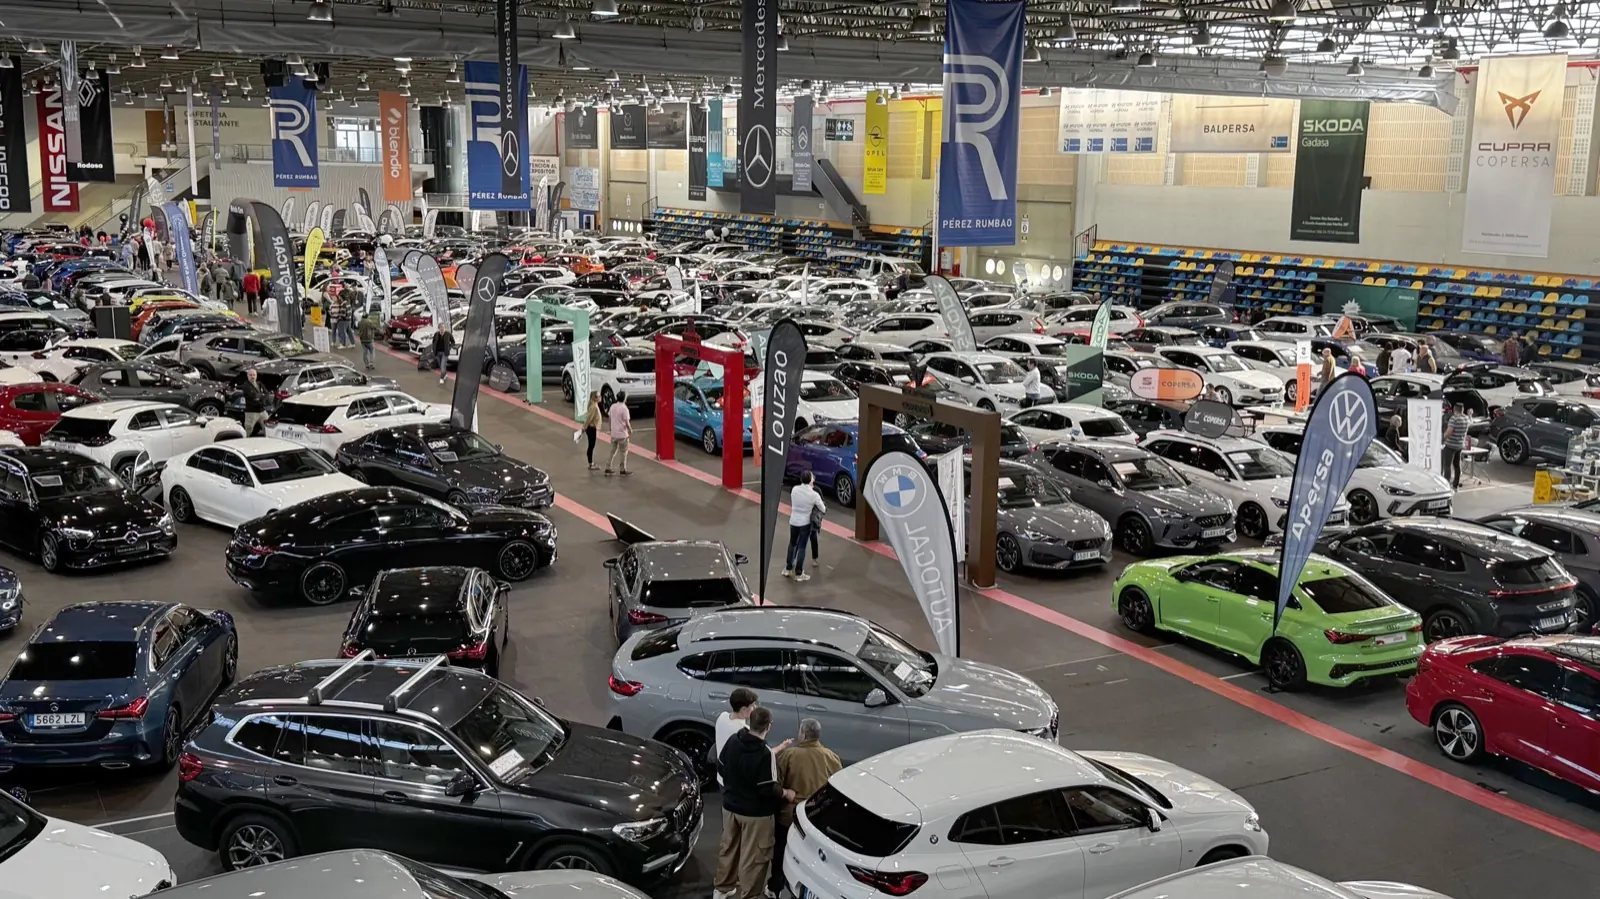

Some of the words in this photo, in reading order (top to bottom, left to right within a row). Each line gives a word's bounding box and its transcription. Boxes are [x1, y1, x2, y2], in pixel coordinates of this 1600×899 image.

[1204, 124, 1255, 133] BALPERSA
[45, 86, 71, 206] NISSAN
[1302, 137, 1329, 147] Gadasa
[1479, 143, 1551, 152] CUPRA
[389, 127, 401, 178] blendio
[1476, 155, 1550, 168] COPERSA
[471, 191, 496, 199] PÉREZ
[942, 217, 972, 228] PÉREZ
[975, 218, 1013, 228] RUMBAO
[1067, 371, 1100, 380] SKODA
[1161, 381, 1197, 389] COPERSA
[768, 350, 788, 456] Louzao
[1292, 448, 1334, 542] Apersa
[36, 714, 61, 725] 5662
[64, 713, 83, 724] LZL
